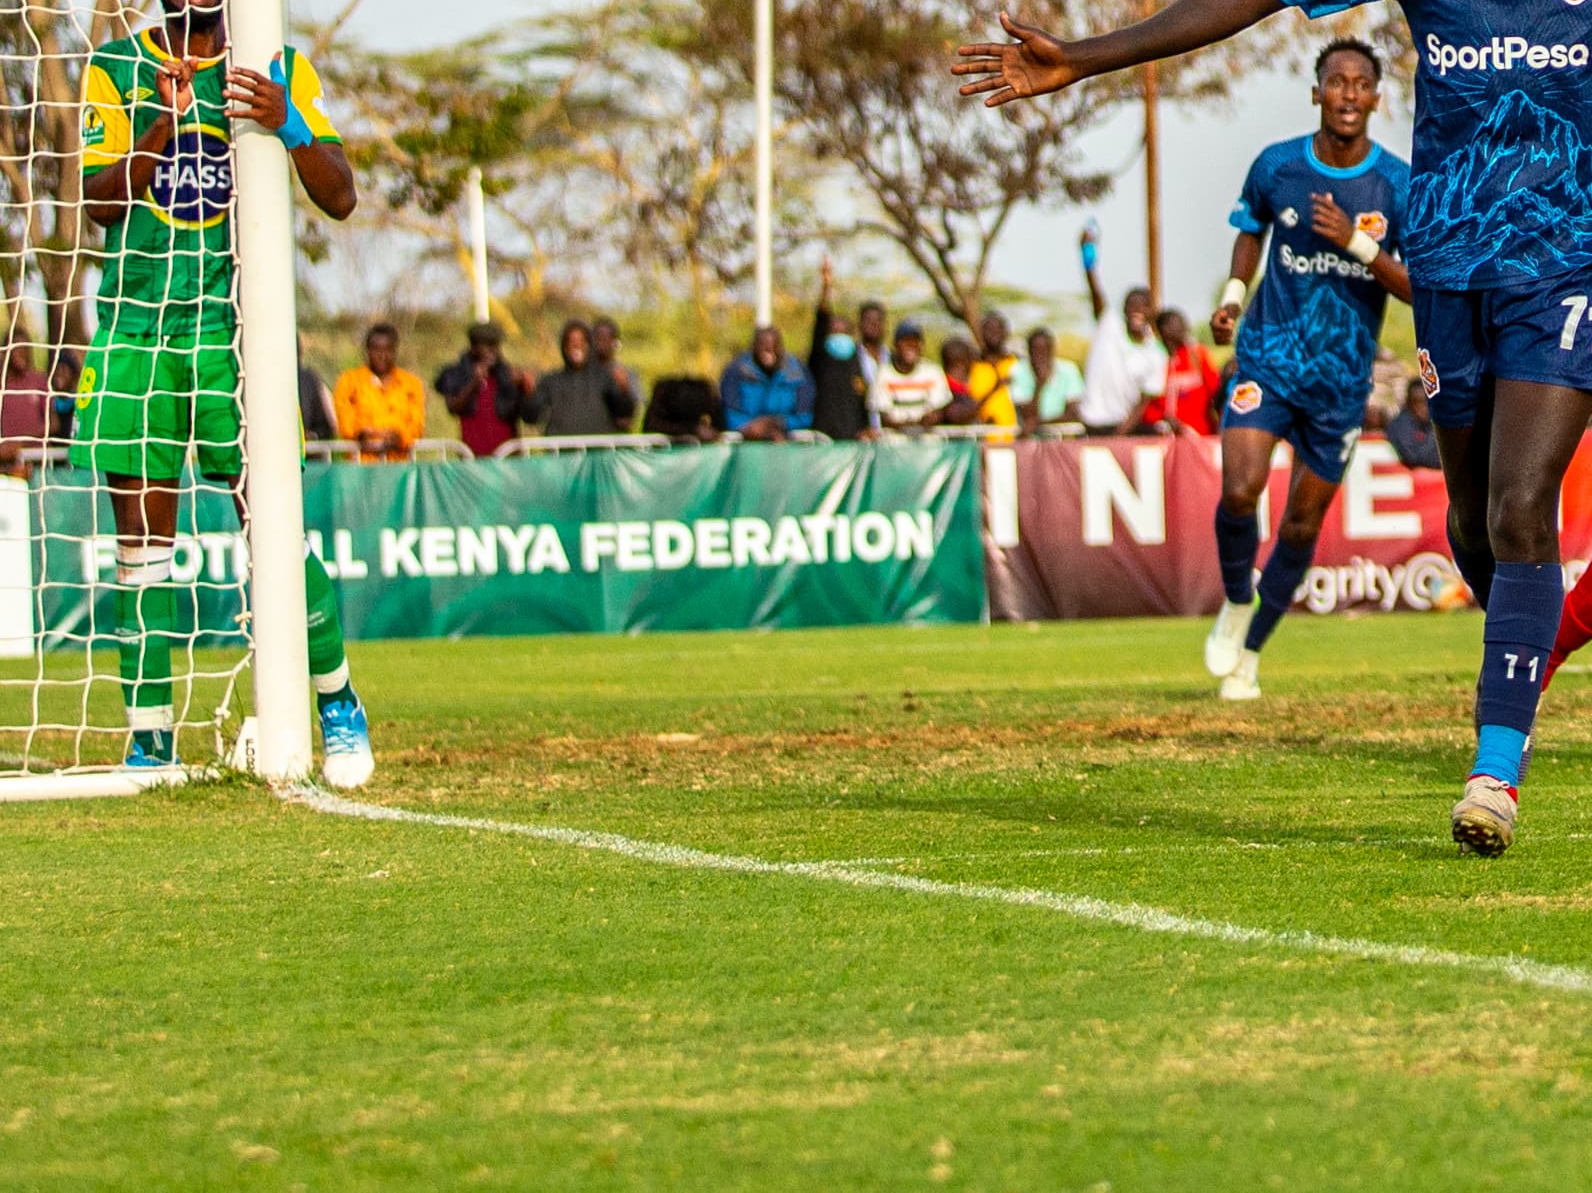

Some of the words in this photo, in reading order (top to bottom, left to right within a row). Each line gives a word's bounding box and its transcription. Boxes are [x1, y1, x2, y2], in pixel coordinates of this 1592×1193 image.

[1427, 33, 1589, 76] SportPesa
[155, 164, 232, 189] HASS
[379, 523, 570, 578] KENYA
[581, 512, 935, 573] FEDERATION
[1505, 653, 1539, 682] 71
